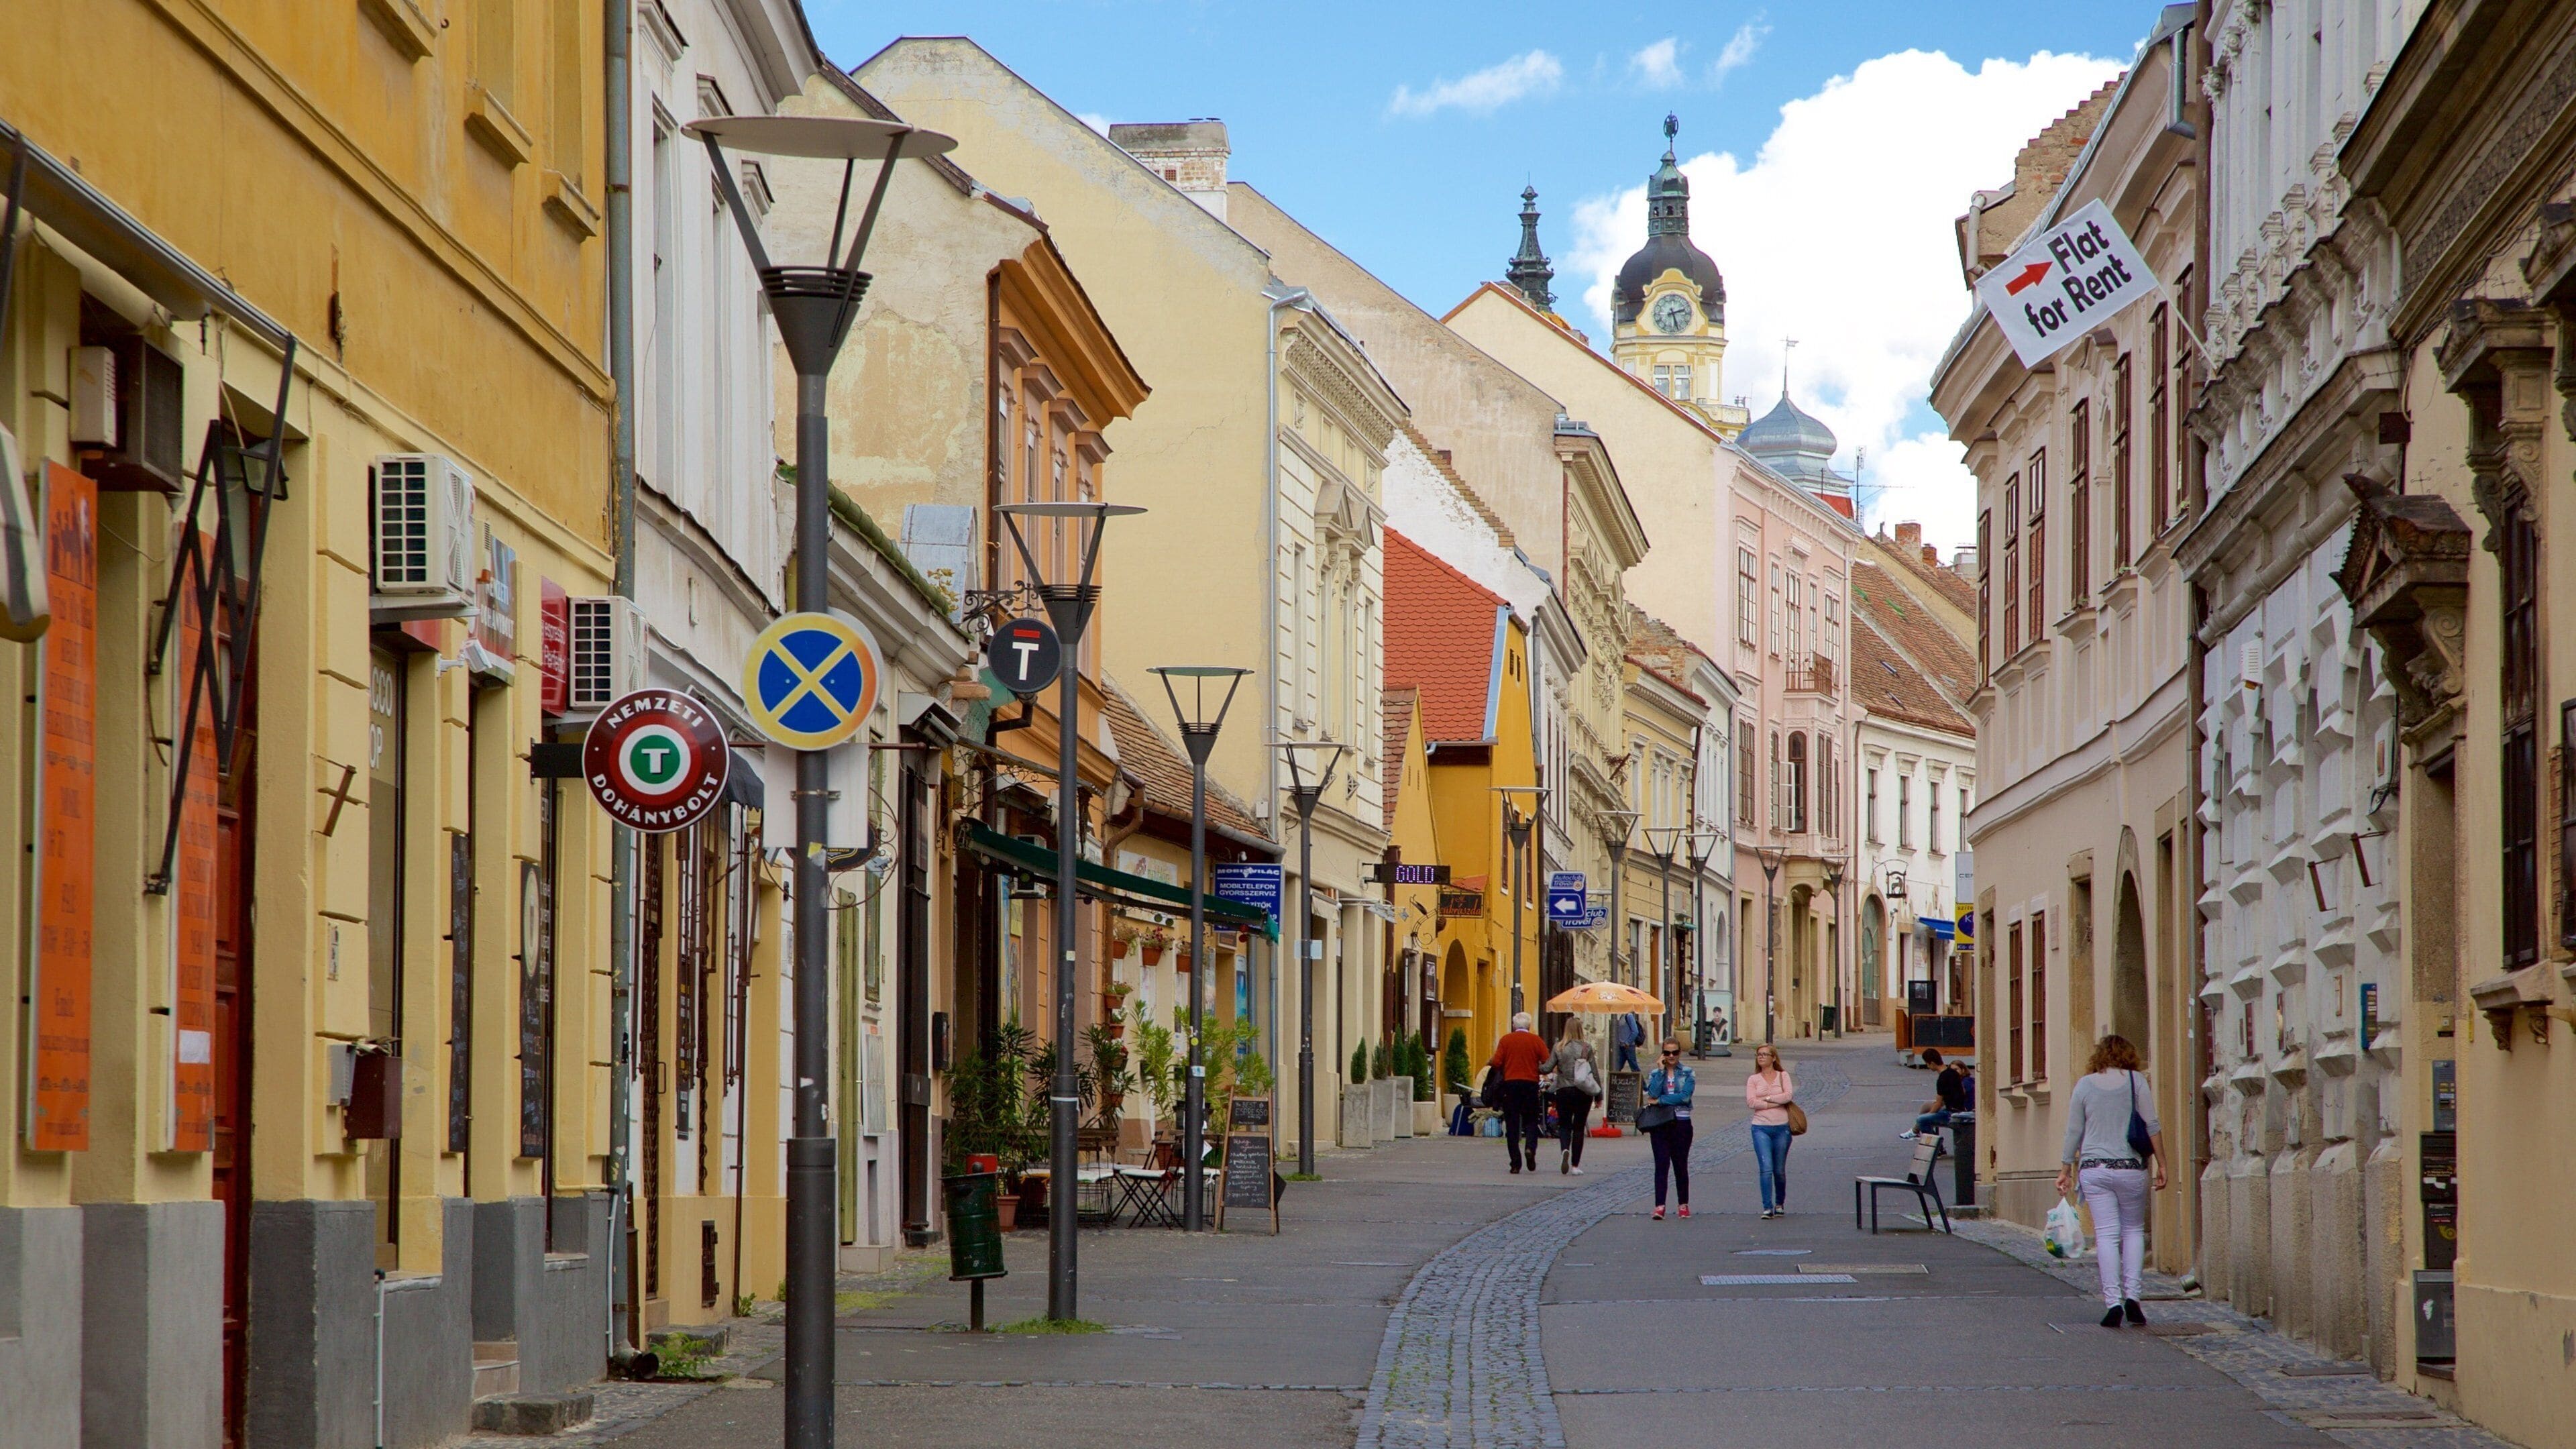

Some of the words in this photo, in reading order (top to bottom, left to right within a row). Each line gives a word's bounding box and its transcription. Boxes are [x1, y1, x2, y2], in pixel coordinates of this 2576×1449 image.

[2047, 220, 2110, 274] Flat
[2024, 298, 2069, 338] for
[2061, 254, 2132, 313] Rent
[1012, 642, 1039, 680] T
[370, 667, 393, 717] CCO
[606, 697, 704, 729] NEMZETI
[641, 748, 671, 774] T
[592, 772, 718, 825] DOHÁNYBOLT
[1396, 865, 1434, 883] GOLD
[1235, 1108, 1268, 1117] ESPRESSO
